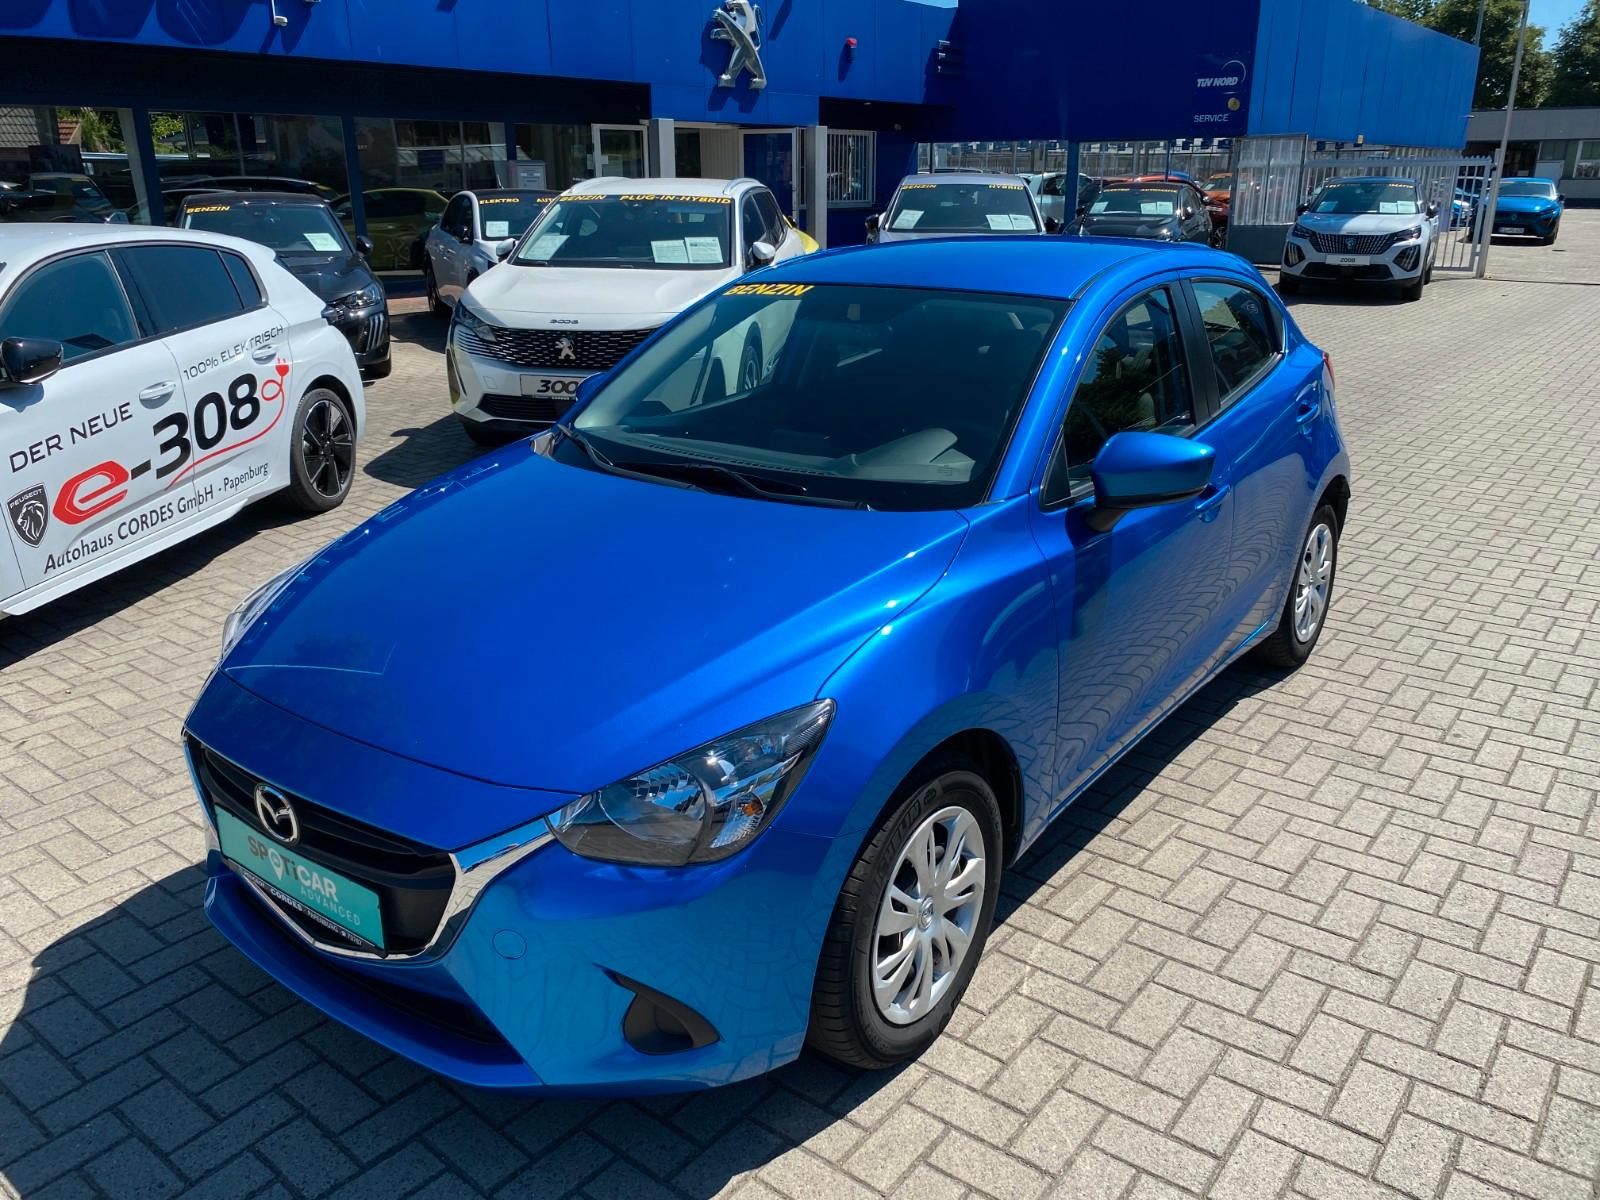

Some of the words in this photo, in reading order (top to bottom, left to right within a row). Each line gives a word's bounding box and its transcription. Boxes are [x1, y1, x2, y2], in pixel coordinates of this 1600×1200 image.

[1213, 76, 1239, 87] NORD
[1194, 113, 1229, 123] SERVICE
[619, 194, 731, 204] PLUG-IN-HYBRID
[186, 205, 230, 214] BENZIN
[722, 284, 815, 296] BENZIN
[184, 357, 219, 380] 100%
[220, 325, 283, 363] ELEKTRISCH
[9, 434, 64, 473] DER
[70, 402, 133, 445] NEUE
[10, 489, 43, 509] PEUGEOT
[44, 533, 114, 575] Autohaus
[117, 502, 174, 540] CORDES
[177, 484, 214, 514] GmbH
[223, 462, 269, 492] Papenburg
[301, 886, 361, 926] ADVANCED
